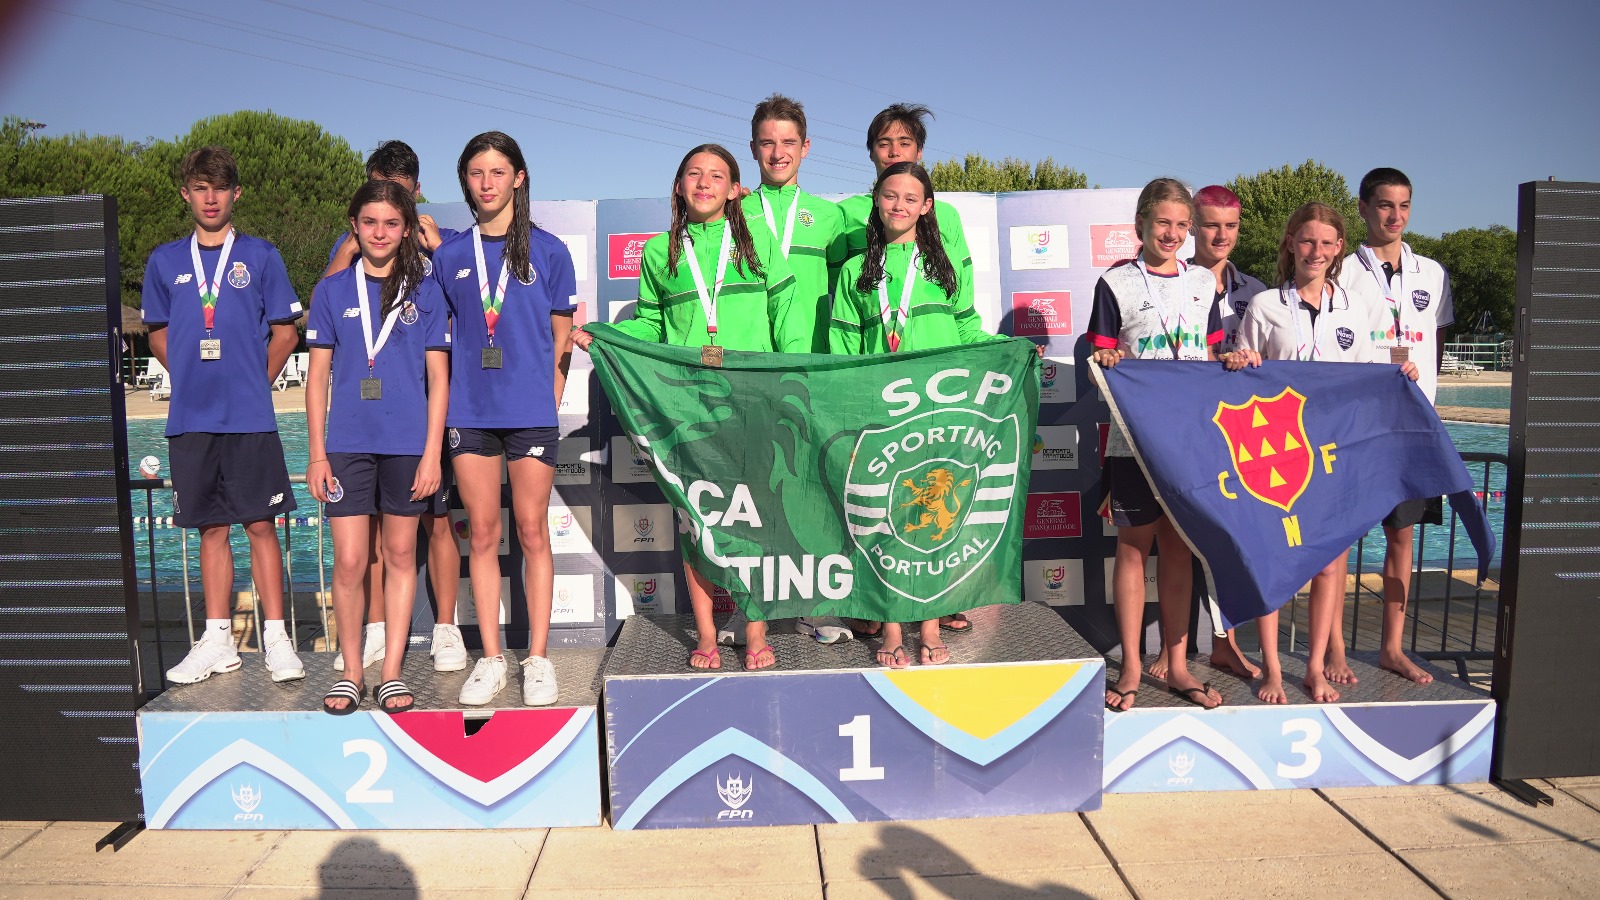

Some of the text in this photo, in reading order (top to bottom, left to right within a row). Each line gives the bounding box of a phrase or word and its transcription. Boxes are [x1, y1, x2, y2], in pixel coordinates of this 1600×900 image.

[881, 368, 1012, 417] SCP
[868, 426, 1001, 477] SPORTING
[727, 554, 853, 601] TING
[871, 537, 989, 575] PORTUGAL
[1042, 566, 1065, 581] ipdj
[633, 579, 657, 594] ipdj
[342, 738, 394, 803] 2
[838, 714, 885, 781] 1
[1277, 718, 1322, 779] 3
[233, 813, 264, 821] FPN
[717, 809, 754, 819] FPN
